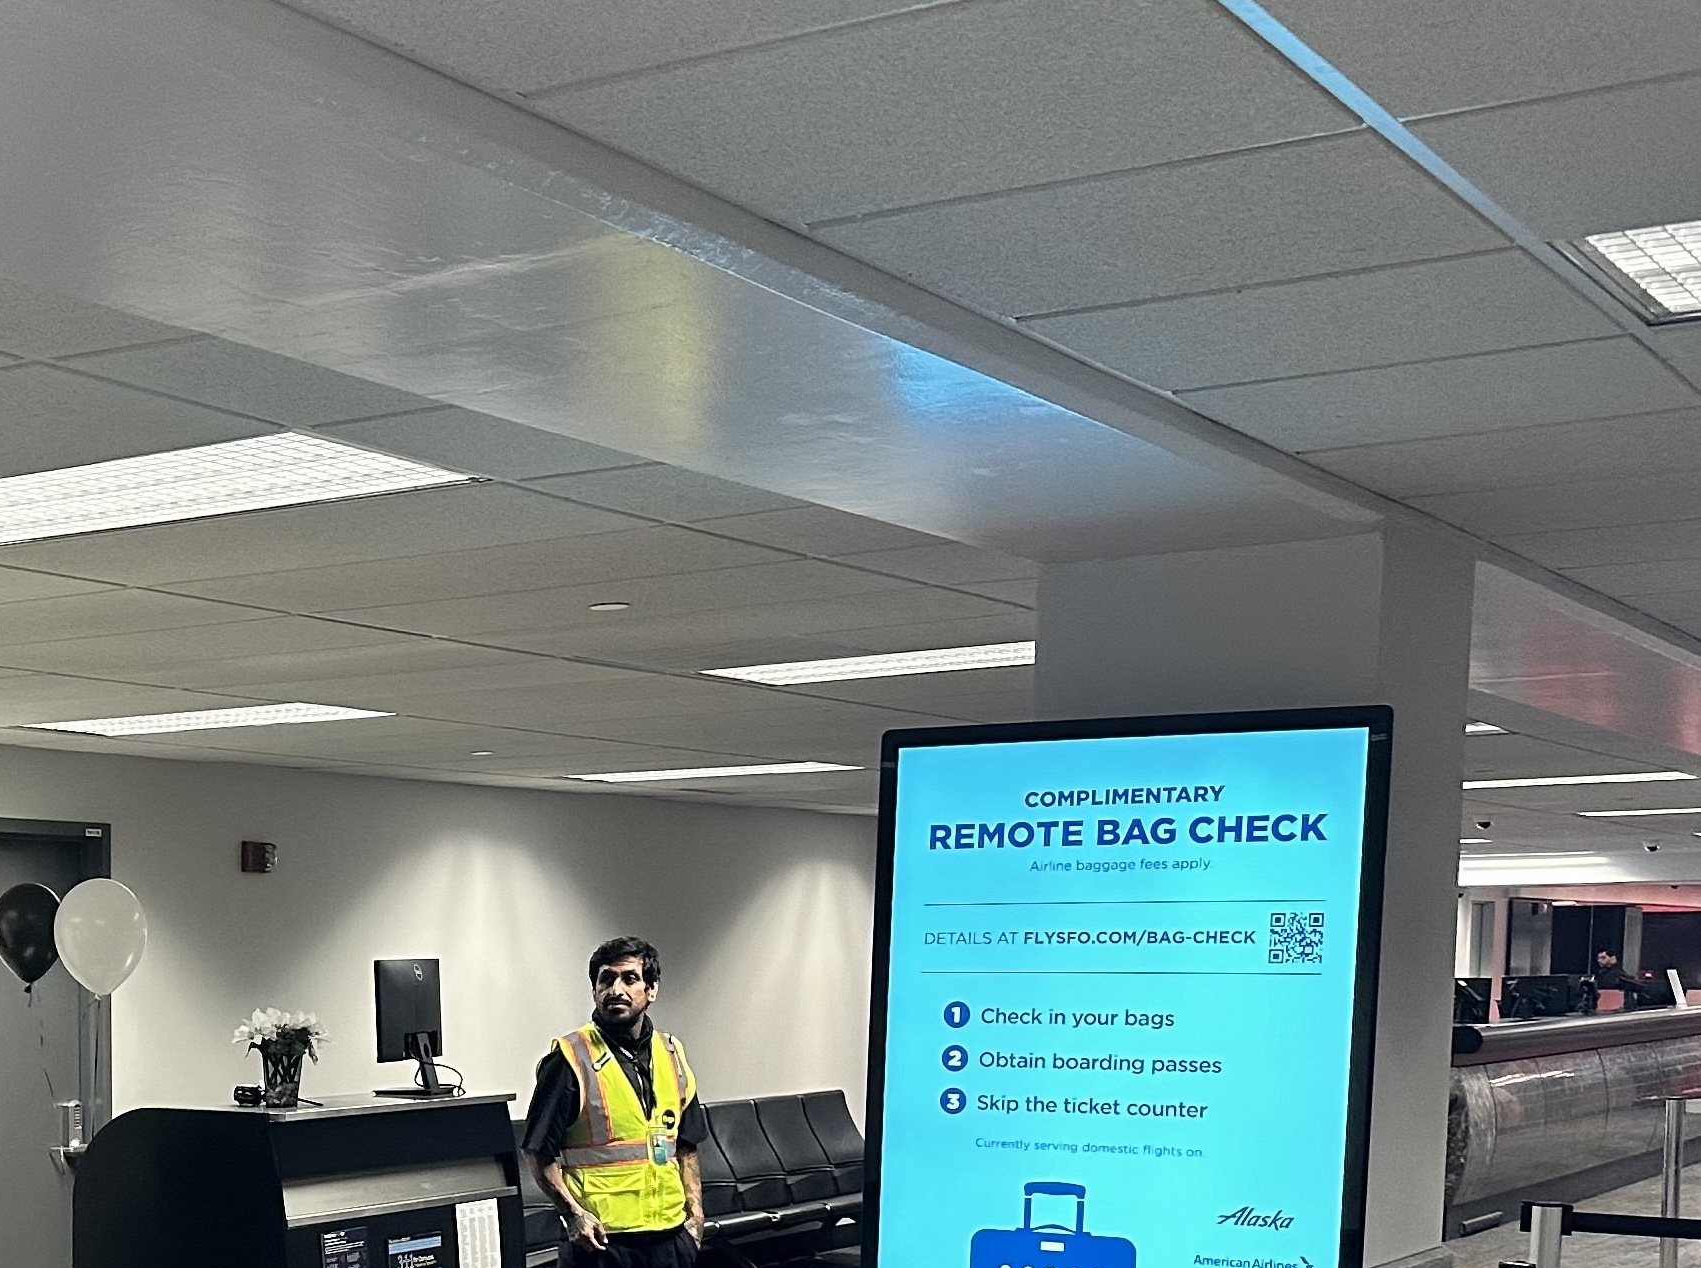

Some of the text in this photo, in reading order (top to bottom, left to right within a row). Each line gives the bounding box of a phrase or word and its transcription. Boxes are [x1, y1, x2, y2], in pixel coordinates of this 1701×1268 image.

[1024, 784, 1226, 808] COMPLIMENTARY
[929, 813, 1329, 850] REMOTE BAG CHECK
[1029, 857, 1212, 873] Airline baggage fees apply
[924, 930, 1256, 947] DETAILS AT FLYSFO.COM/BAG-CHECK
[951, 1006, 1175, 1030] 1 Check in your bags
[948, 1050, 1223, 1075] 2 Obtain boarding passes
[946, 1093, 1209, 1119] 3 Skip the ticket counter
[975, 1137, 1031, 1152] Currently
[1033, 1141, 1079, 1154] serving
[1081, 1142, 1139, 1155] domestic
[1142, 1144, 1183, 1158] flights
[1216, 1206, 1295, 1232] Alaska
[1193, 1254, 1250, 1268] American
